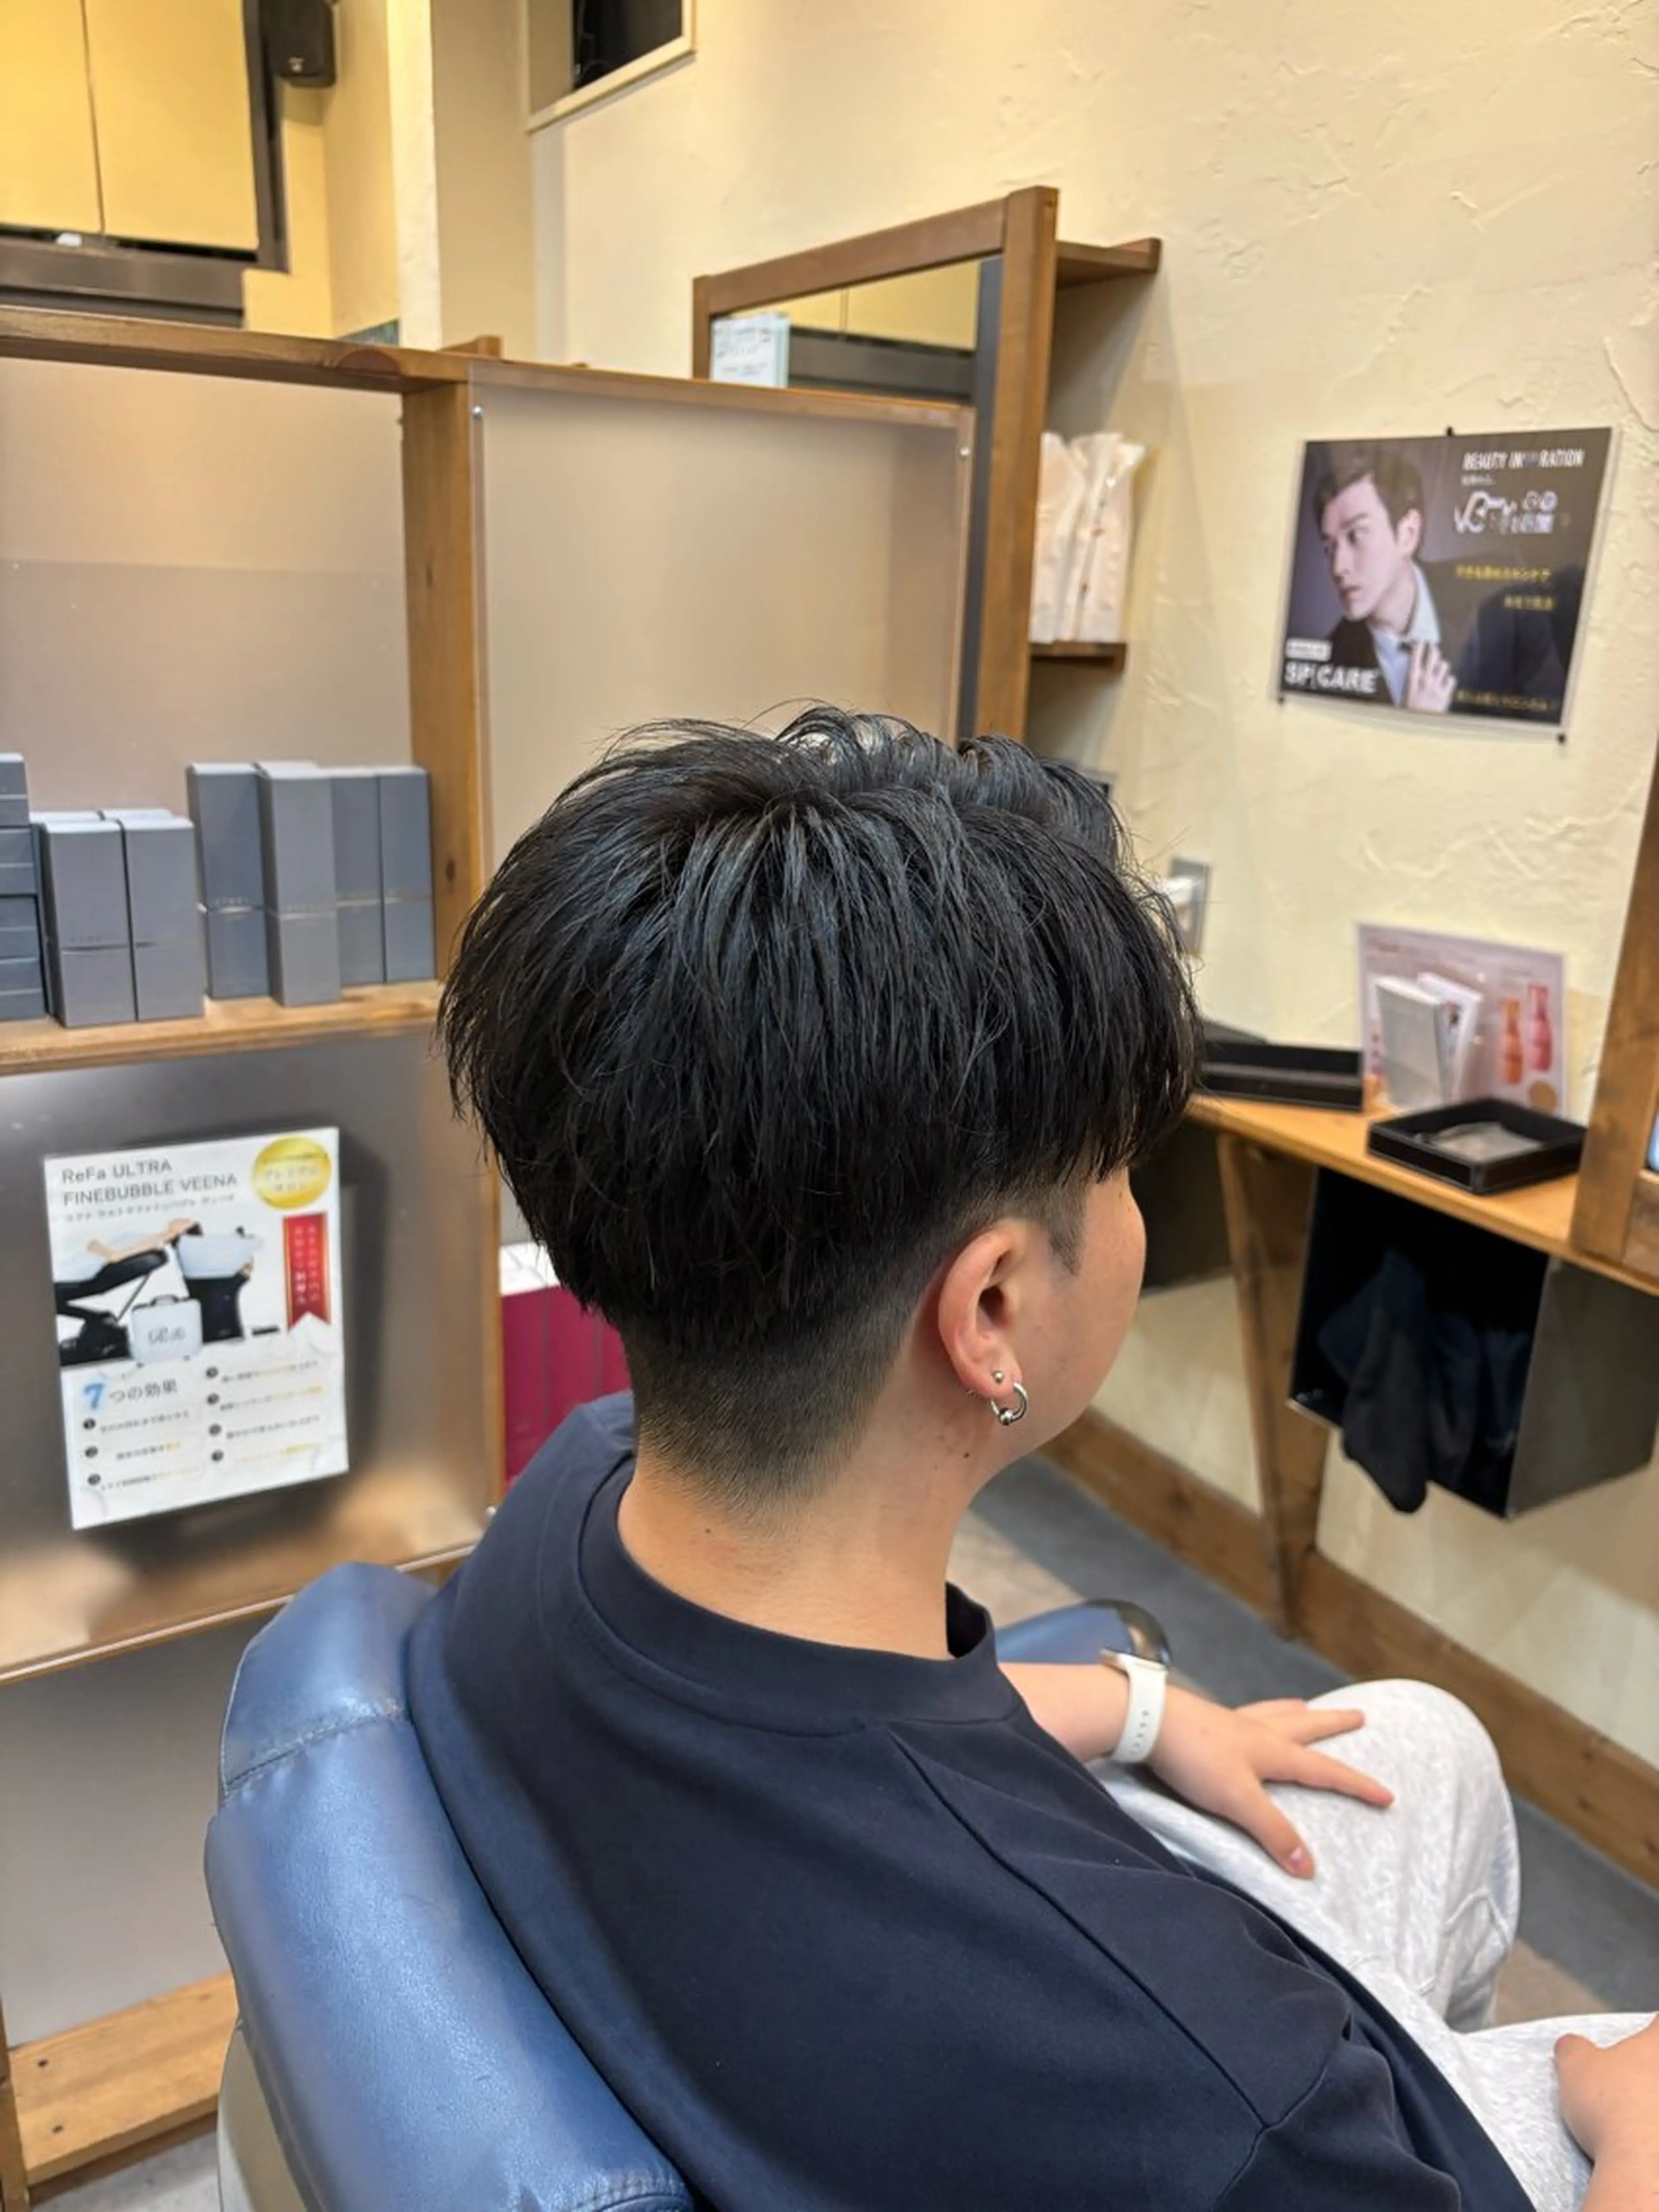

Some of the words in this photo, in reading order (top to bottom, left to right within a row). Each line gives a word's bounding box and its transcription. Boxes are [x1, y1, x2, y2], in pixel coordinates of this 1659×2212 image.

[62, 1167, 106, 1183] ReFa
[112, 1158, 172, 1179] ULTRA
[64, 1180, 174, 1206] FINEBUBBLE
[180, 1173, 237, 1192] VEENA
